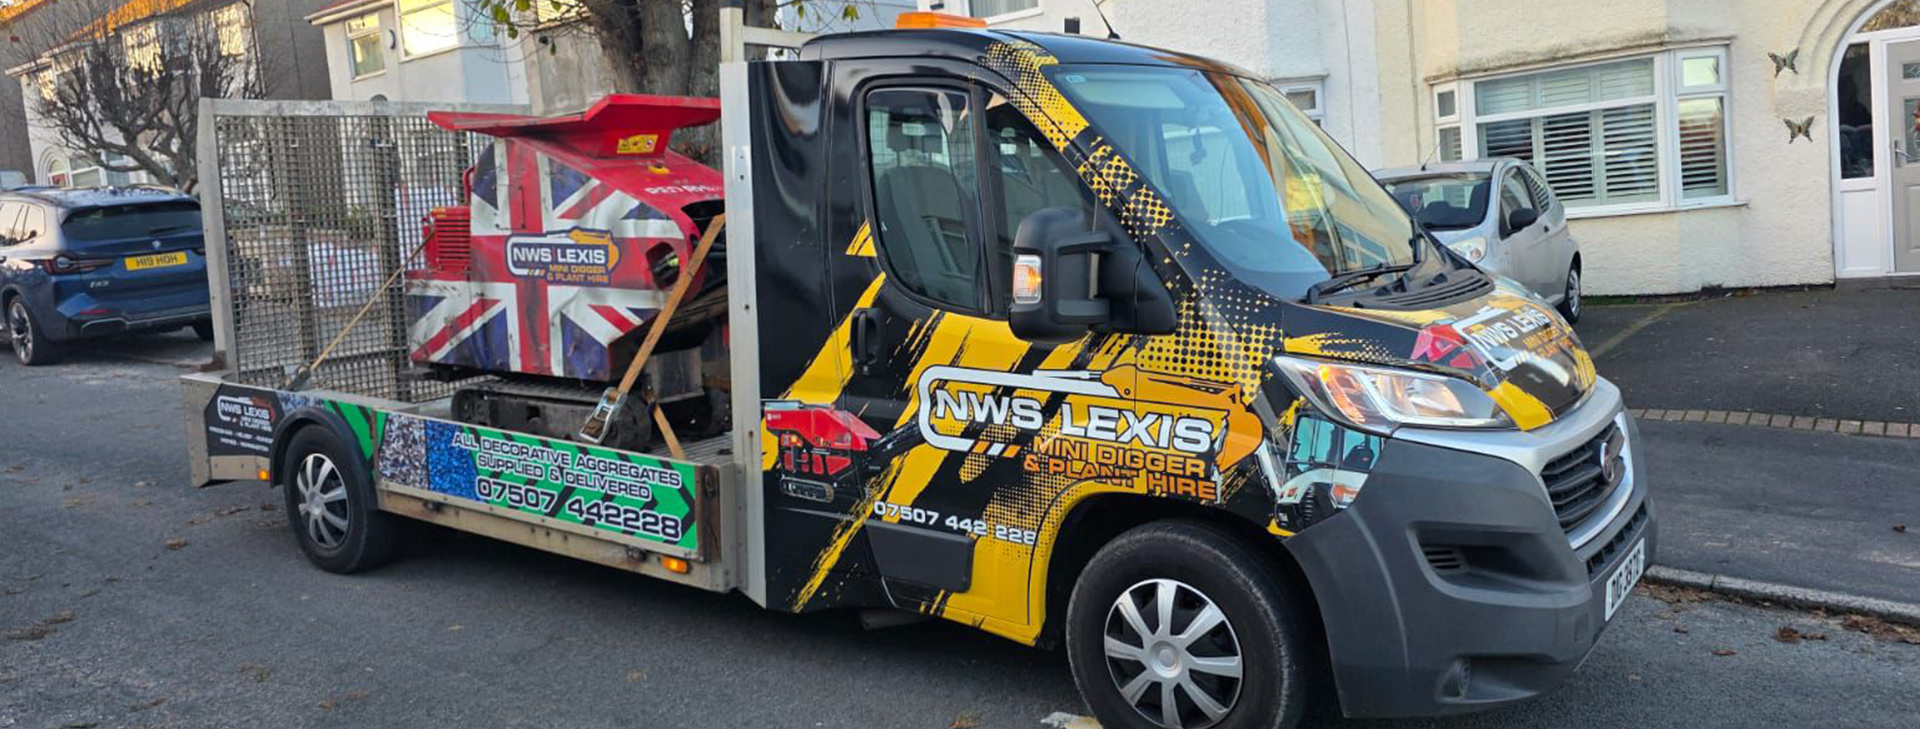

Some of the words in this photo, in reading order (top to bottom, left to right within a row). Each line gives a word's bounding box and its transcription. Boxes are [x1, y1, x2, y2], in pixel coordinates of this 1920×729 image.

[513, 247, 552, 262] NWS
[557, 248, 606, 264] LEXIS
[549, 264, 569, 273] MINI
[571, 265, 606, 273] DIGGER
[556, 273, 585, 282] PLANT
[587, 274, 609, 283] HIRE
[1471, 321, 1519, 351] NWS
[221, 402, 242, 415] NWS
[243, 405, 270, 420] LEXIS
[935, 388, 1043, 431] NWS
[1060, 402, 1215, 453] LEXIS
[452, 431, 479, 449] ALL
[481, 437, 571, 467] DECORATIVE
[575, 454, 682, 488] AGGREGATES
[477, 452, 544, 480] SUPPLIED
[549, 467, 561, 482] &
[564, 472, 652, 500] DELIVERED
[1023, 454, 1040, 473] &
[1049, 457, 1140, 488] PLANT
[1147, 472, 1218, 500] HIRE
[1034, 436, 1089, 460] MINI
[1096, 444, 1206, 478] DIGGER
[476, 476, 557, 512] 07507
[566, 495, 682, 541] 442228
[873, 501, 940, 526] 07507
[945, 515, 988, 536] 442
[994, 525, 1037, 546] 228
